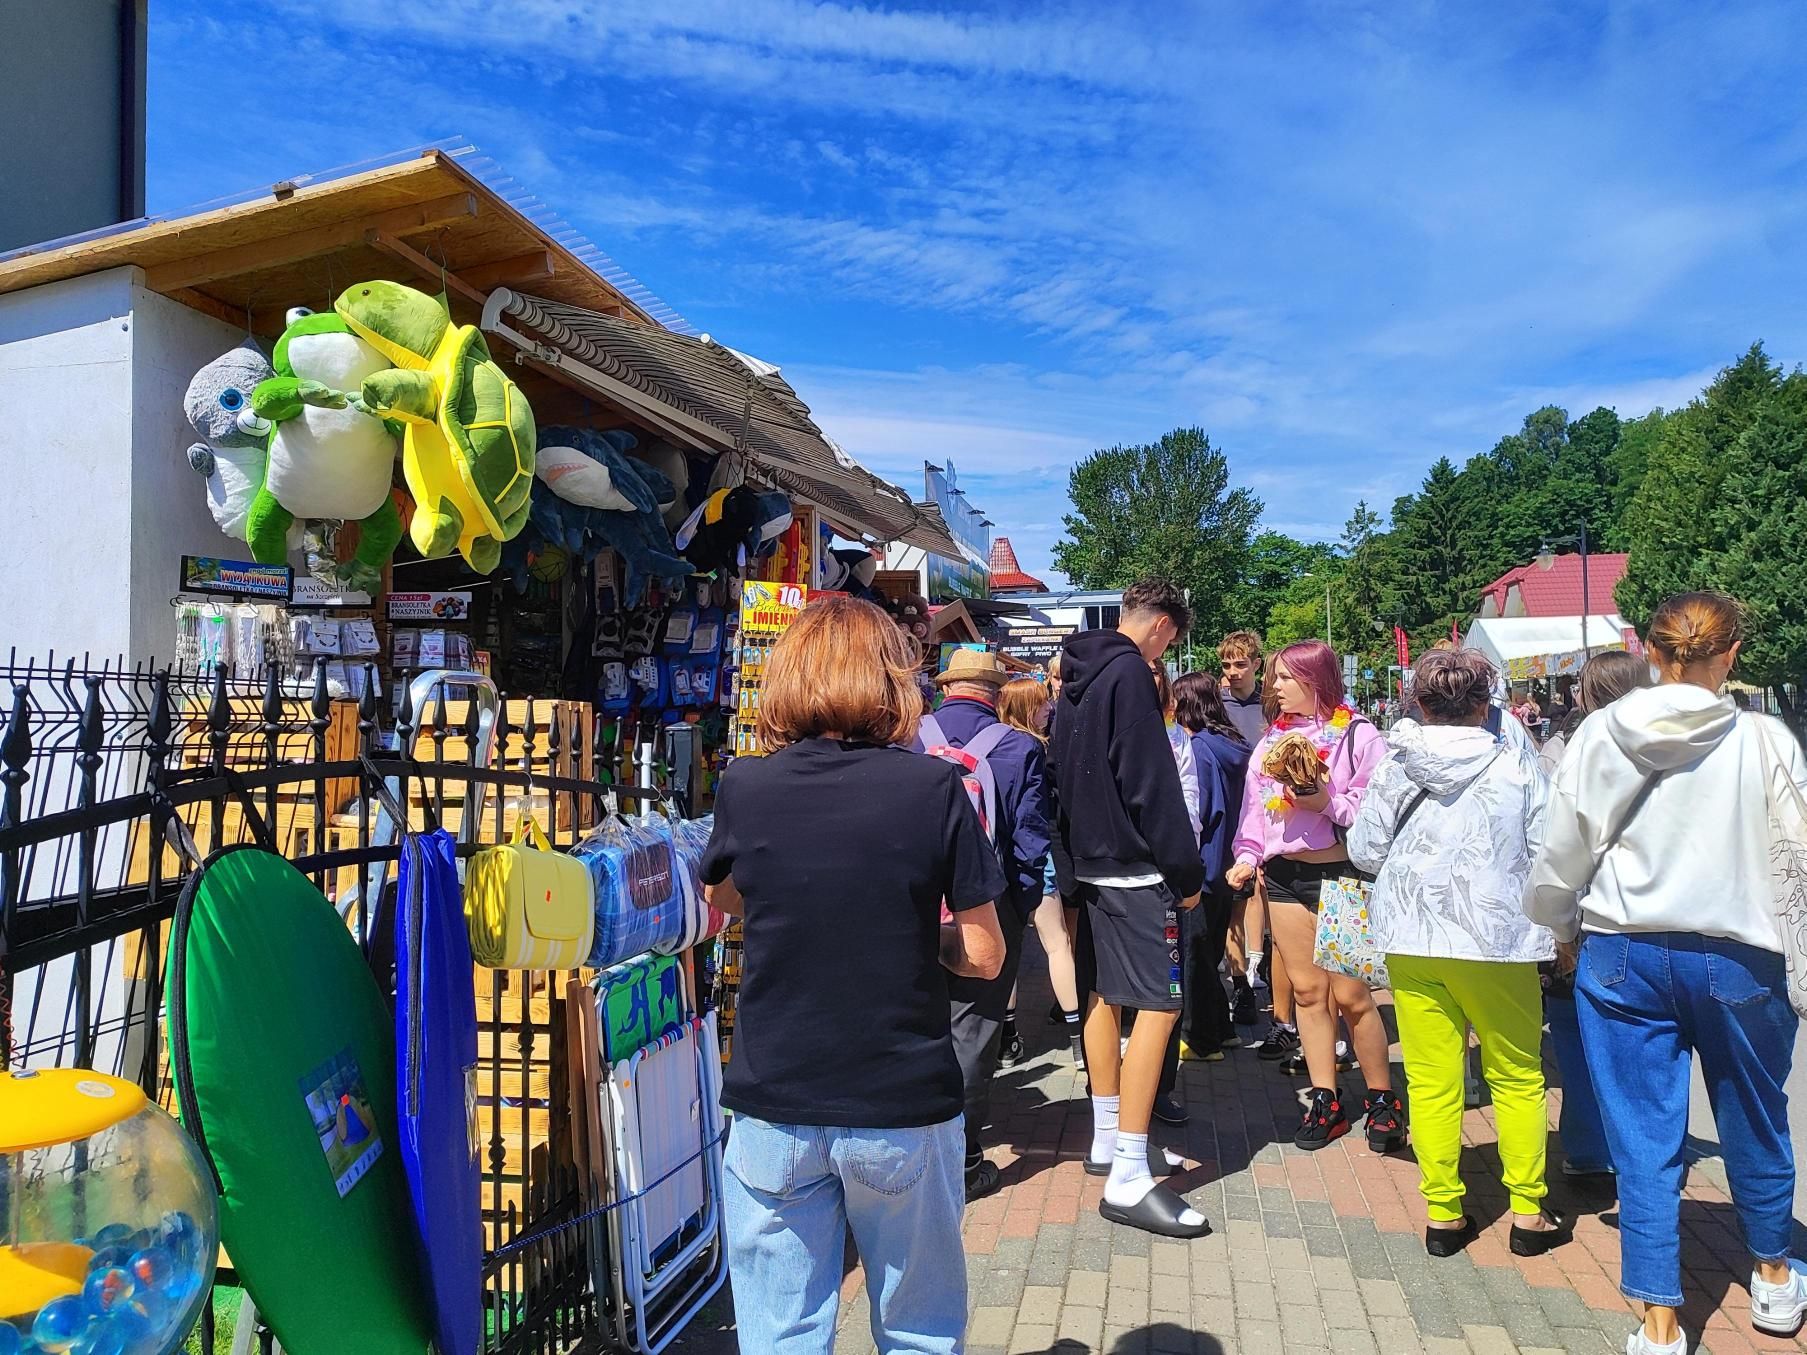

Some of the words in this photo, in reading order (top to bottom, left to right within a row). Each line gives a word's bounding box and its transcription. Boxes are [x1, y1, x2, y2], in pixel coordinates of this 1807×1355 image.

[220, 569, 288, 588] WYJĄTKOWA
[780, 586, 801, 608] 10
[395, 608, 432, 616] NASZYJNIK
[753, 611, 798, 626] IMIENN
